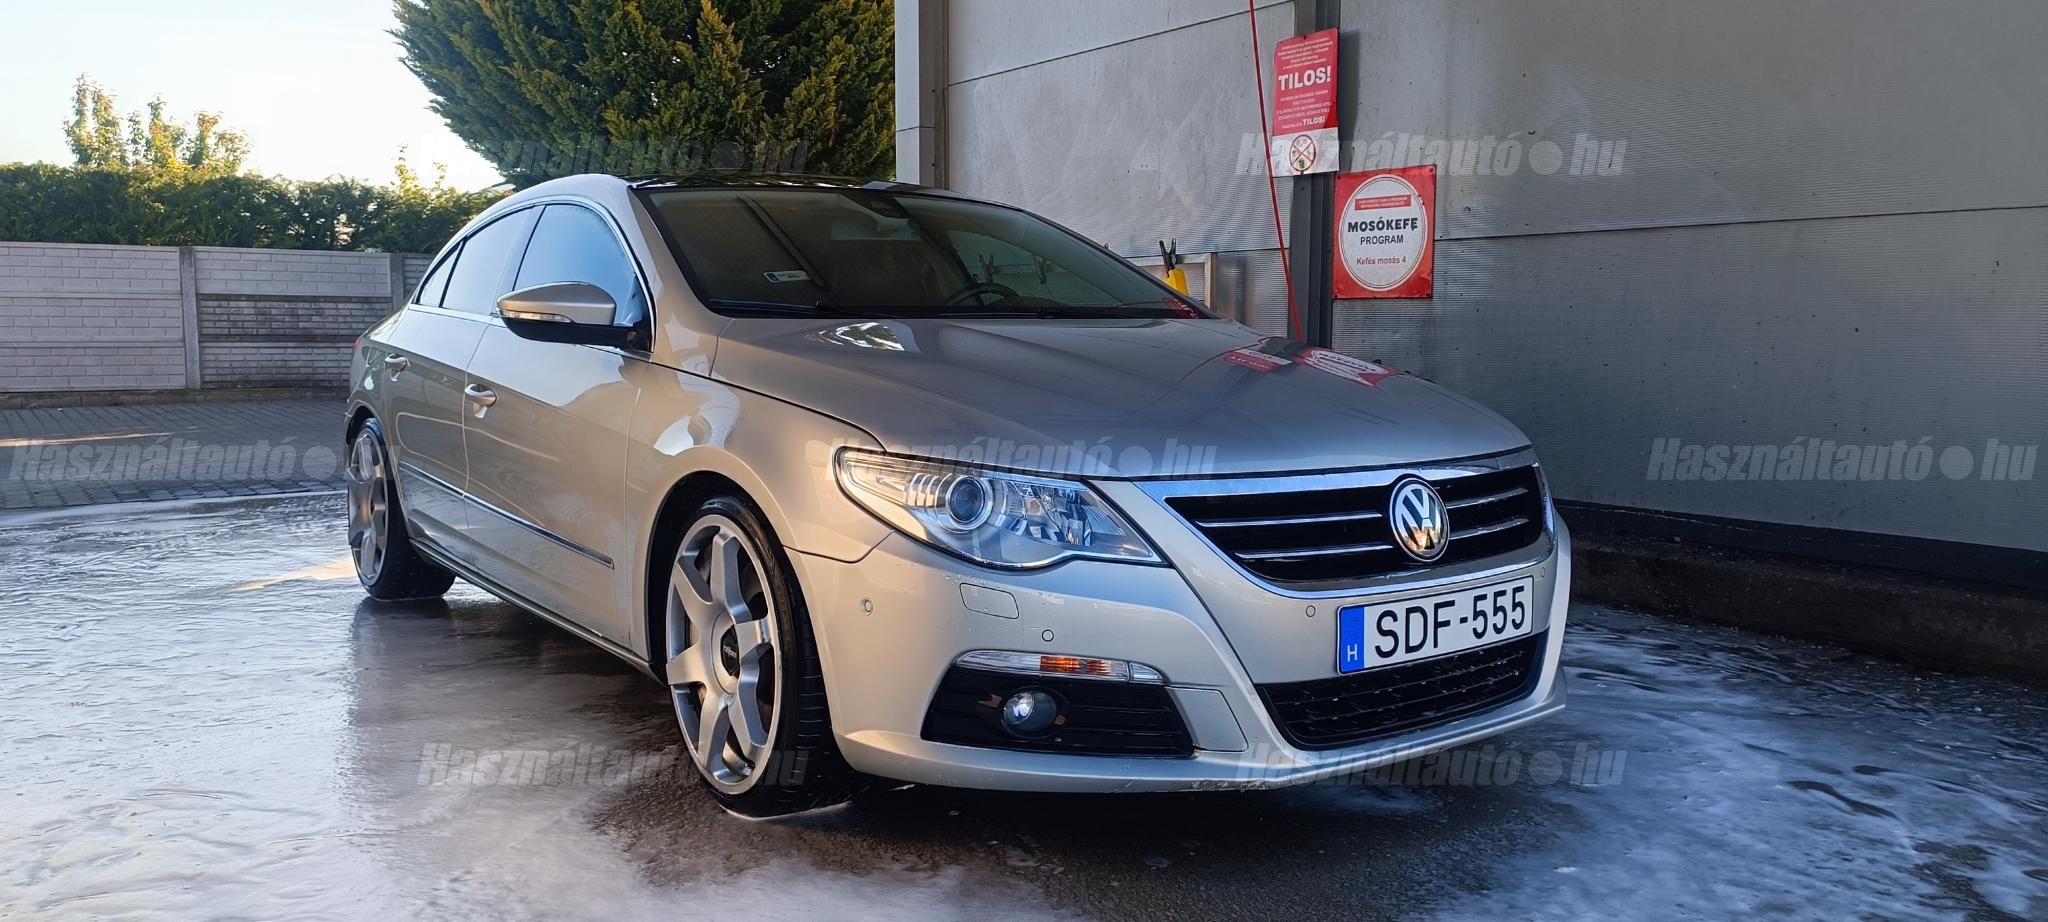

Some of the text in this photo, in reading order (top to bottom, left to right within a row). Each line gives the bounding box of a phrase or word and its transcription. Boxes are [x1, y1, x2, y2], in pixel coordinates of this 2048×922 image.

[1278, 66, 1332, 91] TILOS!
[1303, 116, 1326, 126] TILOS!
[1348, 216, 1418, 233] MOSÓKEFE
[1360, 234, 1404, 246] PROGRAM
[1356, 255, 1407, 265] Kefés mosás 4
[1395, 484, 1445, 557] VW
[1374, 585, 1526, 659] SDF-555
[1347, 643, 1358, 662] H
